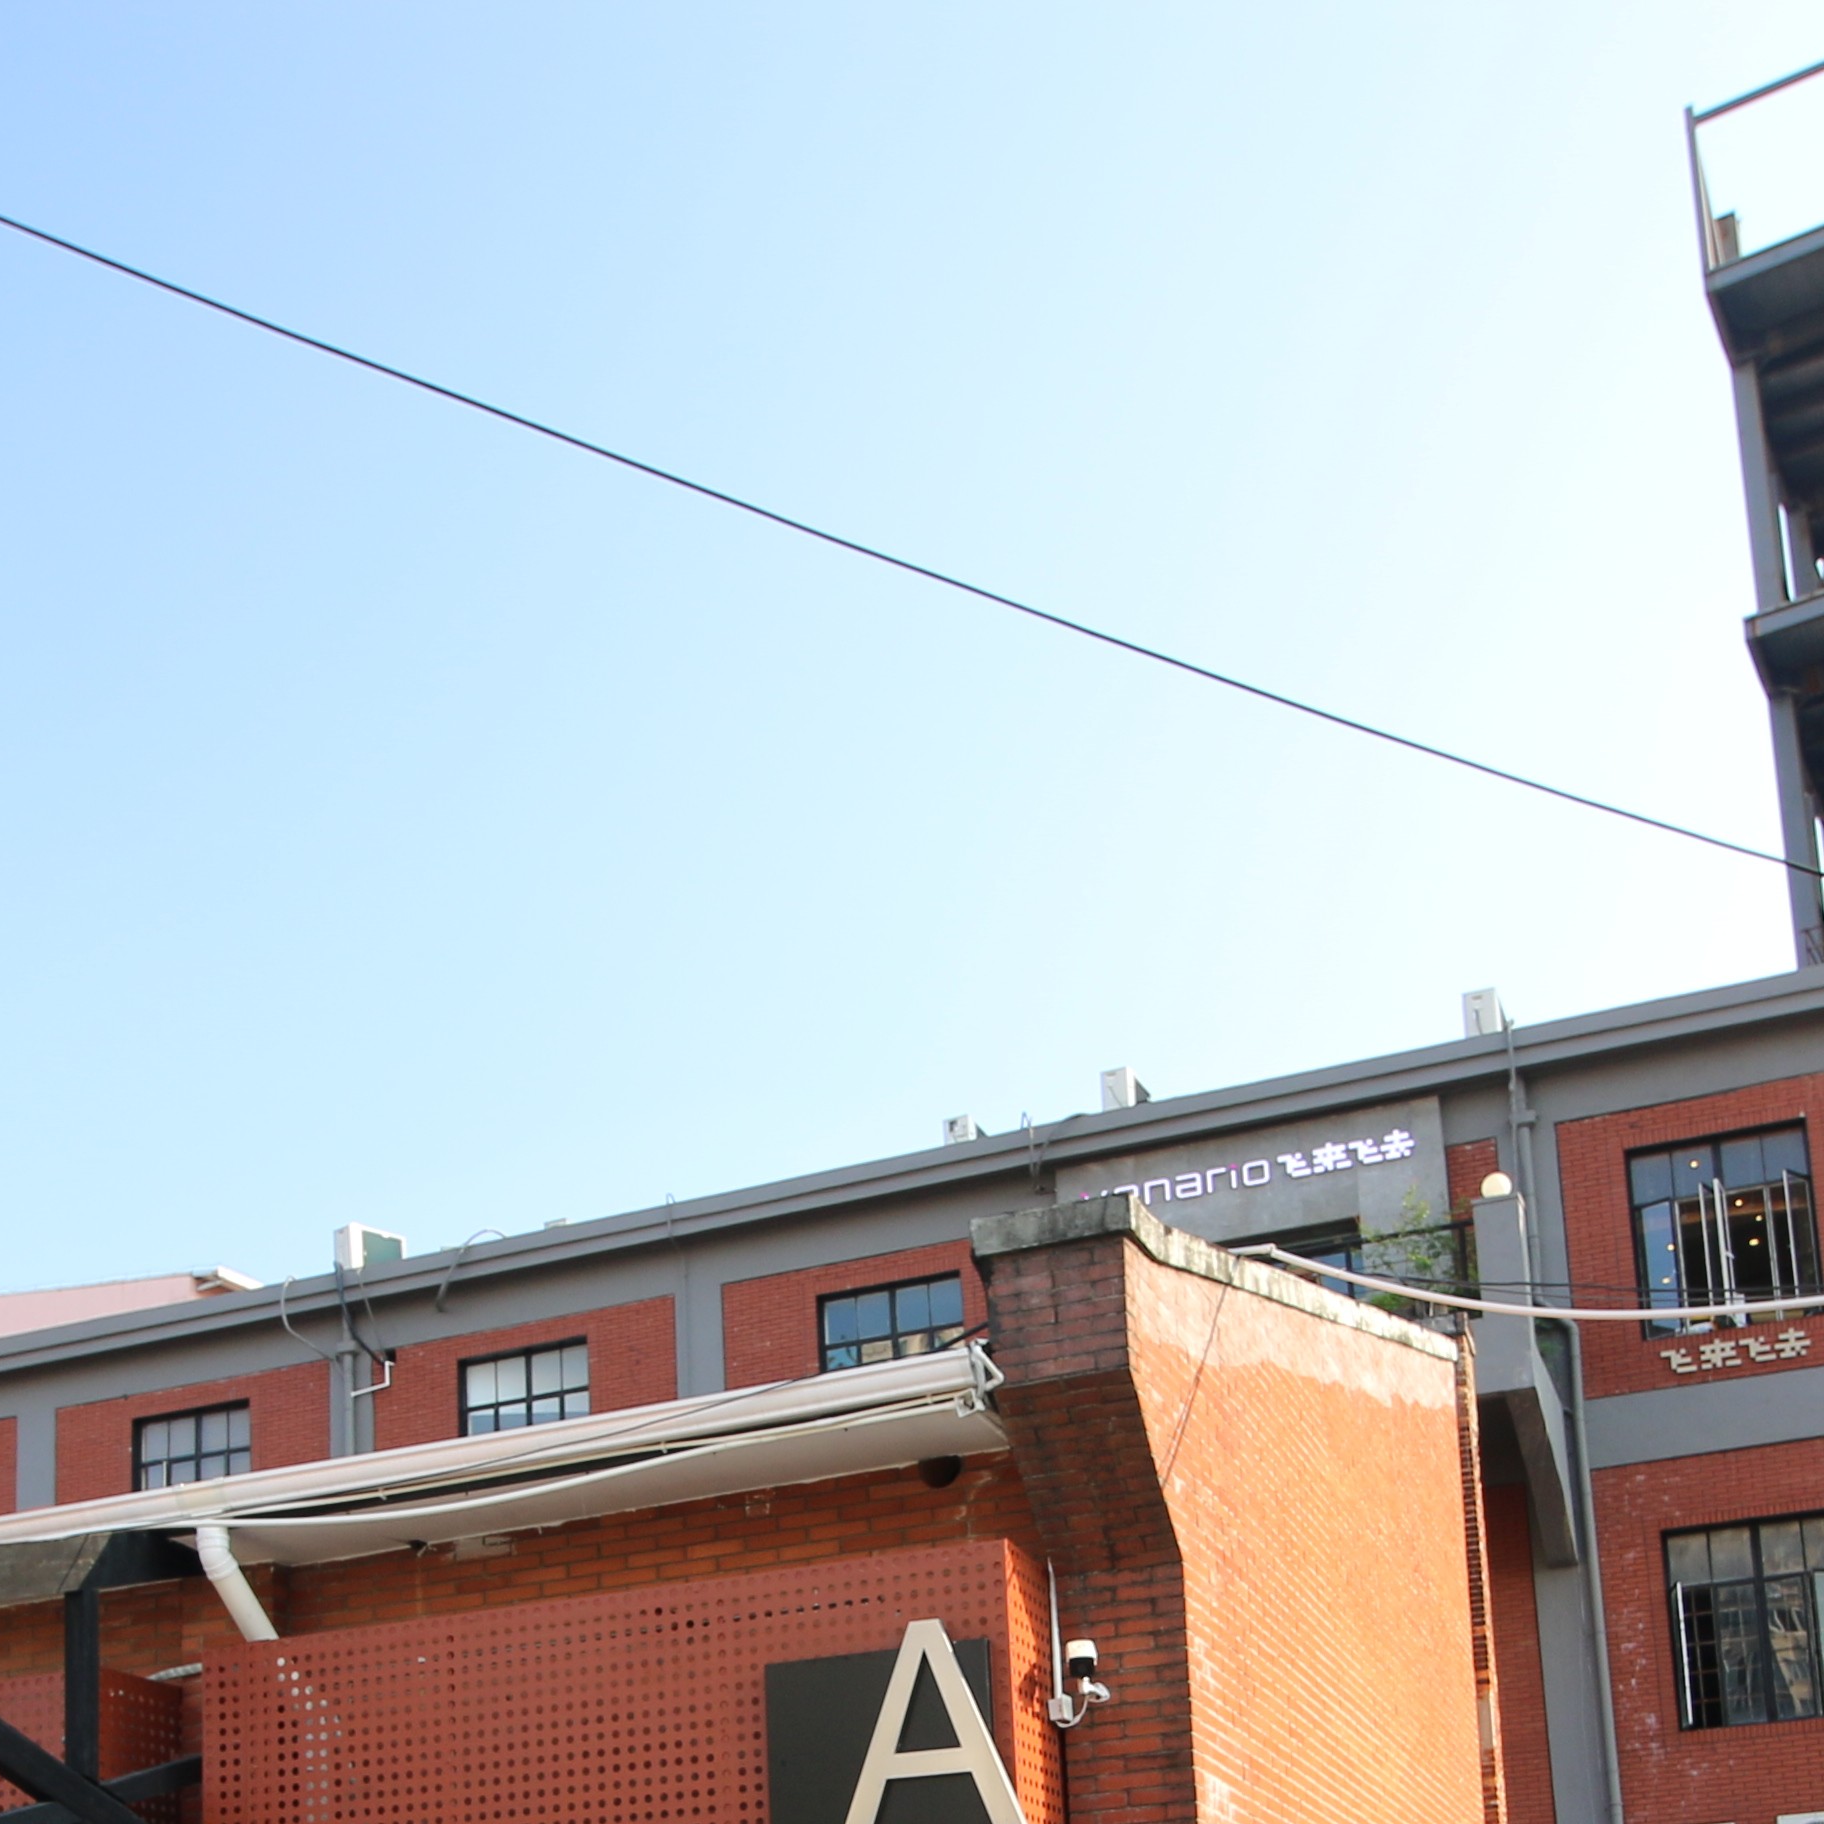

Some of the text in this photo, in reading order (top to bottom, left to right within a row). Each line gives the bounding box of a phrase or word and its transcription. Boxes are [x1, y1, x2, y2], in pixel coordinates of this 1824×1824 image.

[1079, 1129, 1415, 1206] nario 飞来飞去
[1660, 1327, 1811, 1374] 飞来飞去
